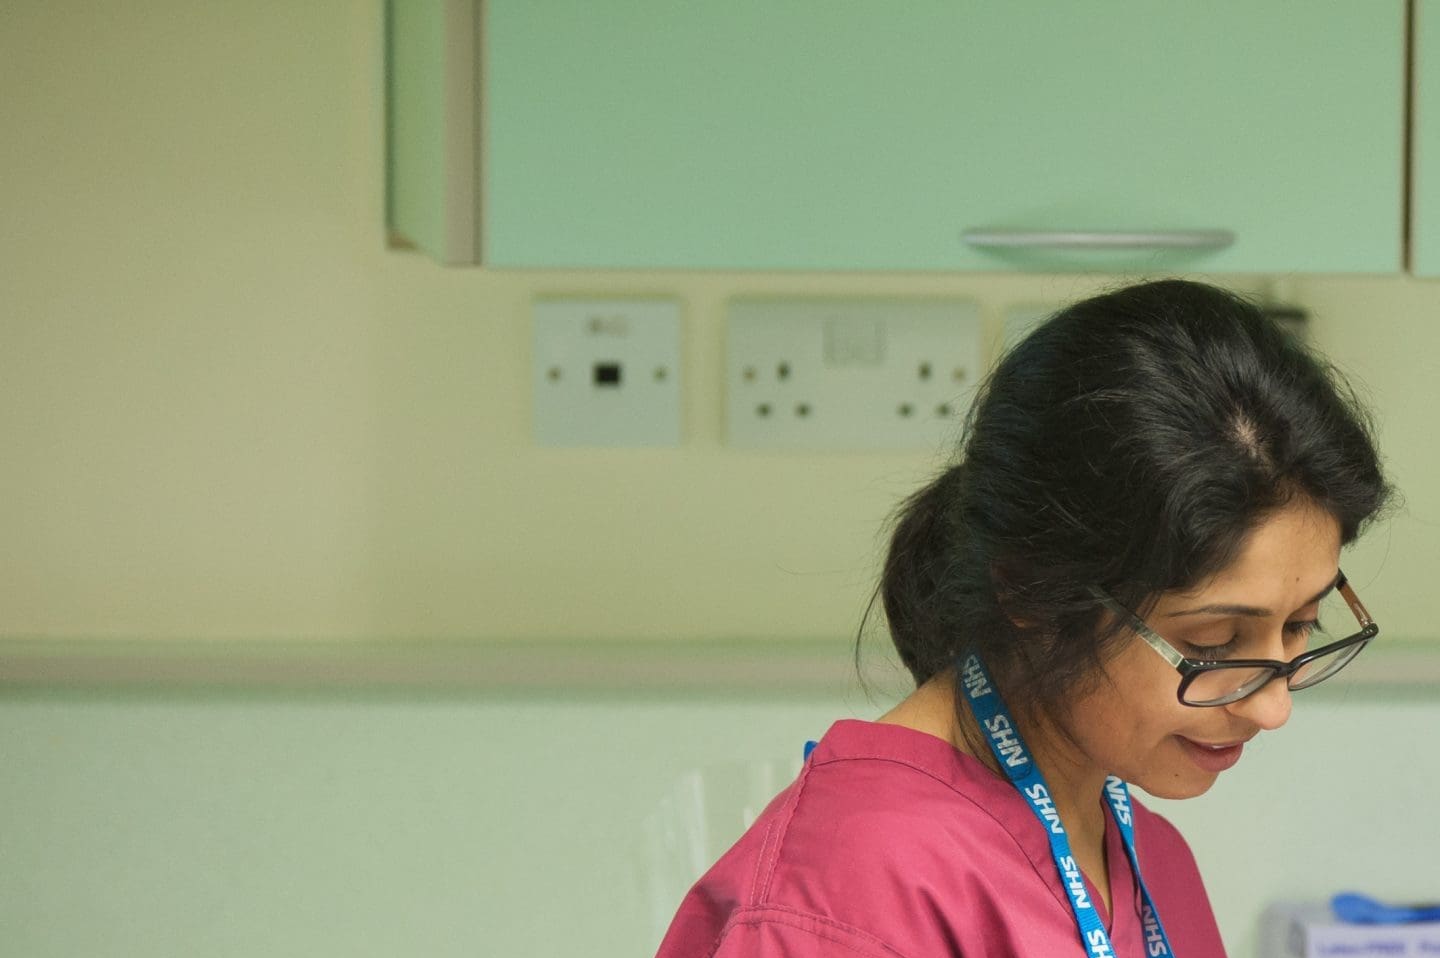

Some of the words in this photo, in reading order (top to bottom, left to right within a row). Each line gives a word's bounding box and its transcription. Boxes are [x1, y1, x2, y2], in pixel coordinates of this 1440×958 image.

[983, 713, 1028, 768] NHS
[1025, 783, 1064, 834] NHS
[1106, 775, 1132, 827] NHS
[1060, 855, 1091, 909] NHS
[1143, 904, 1167, 957] NHS
